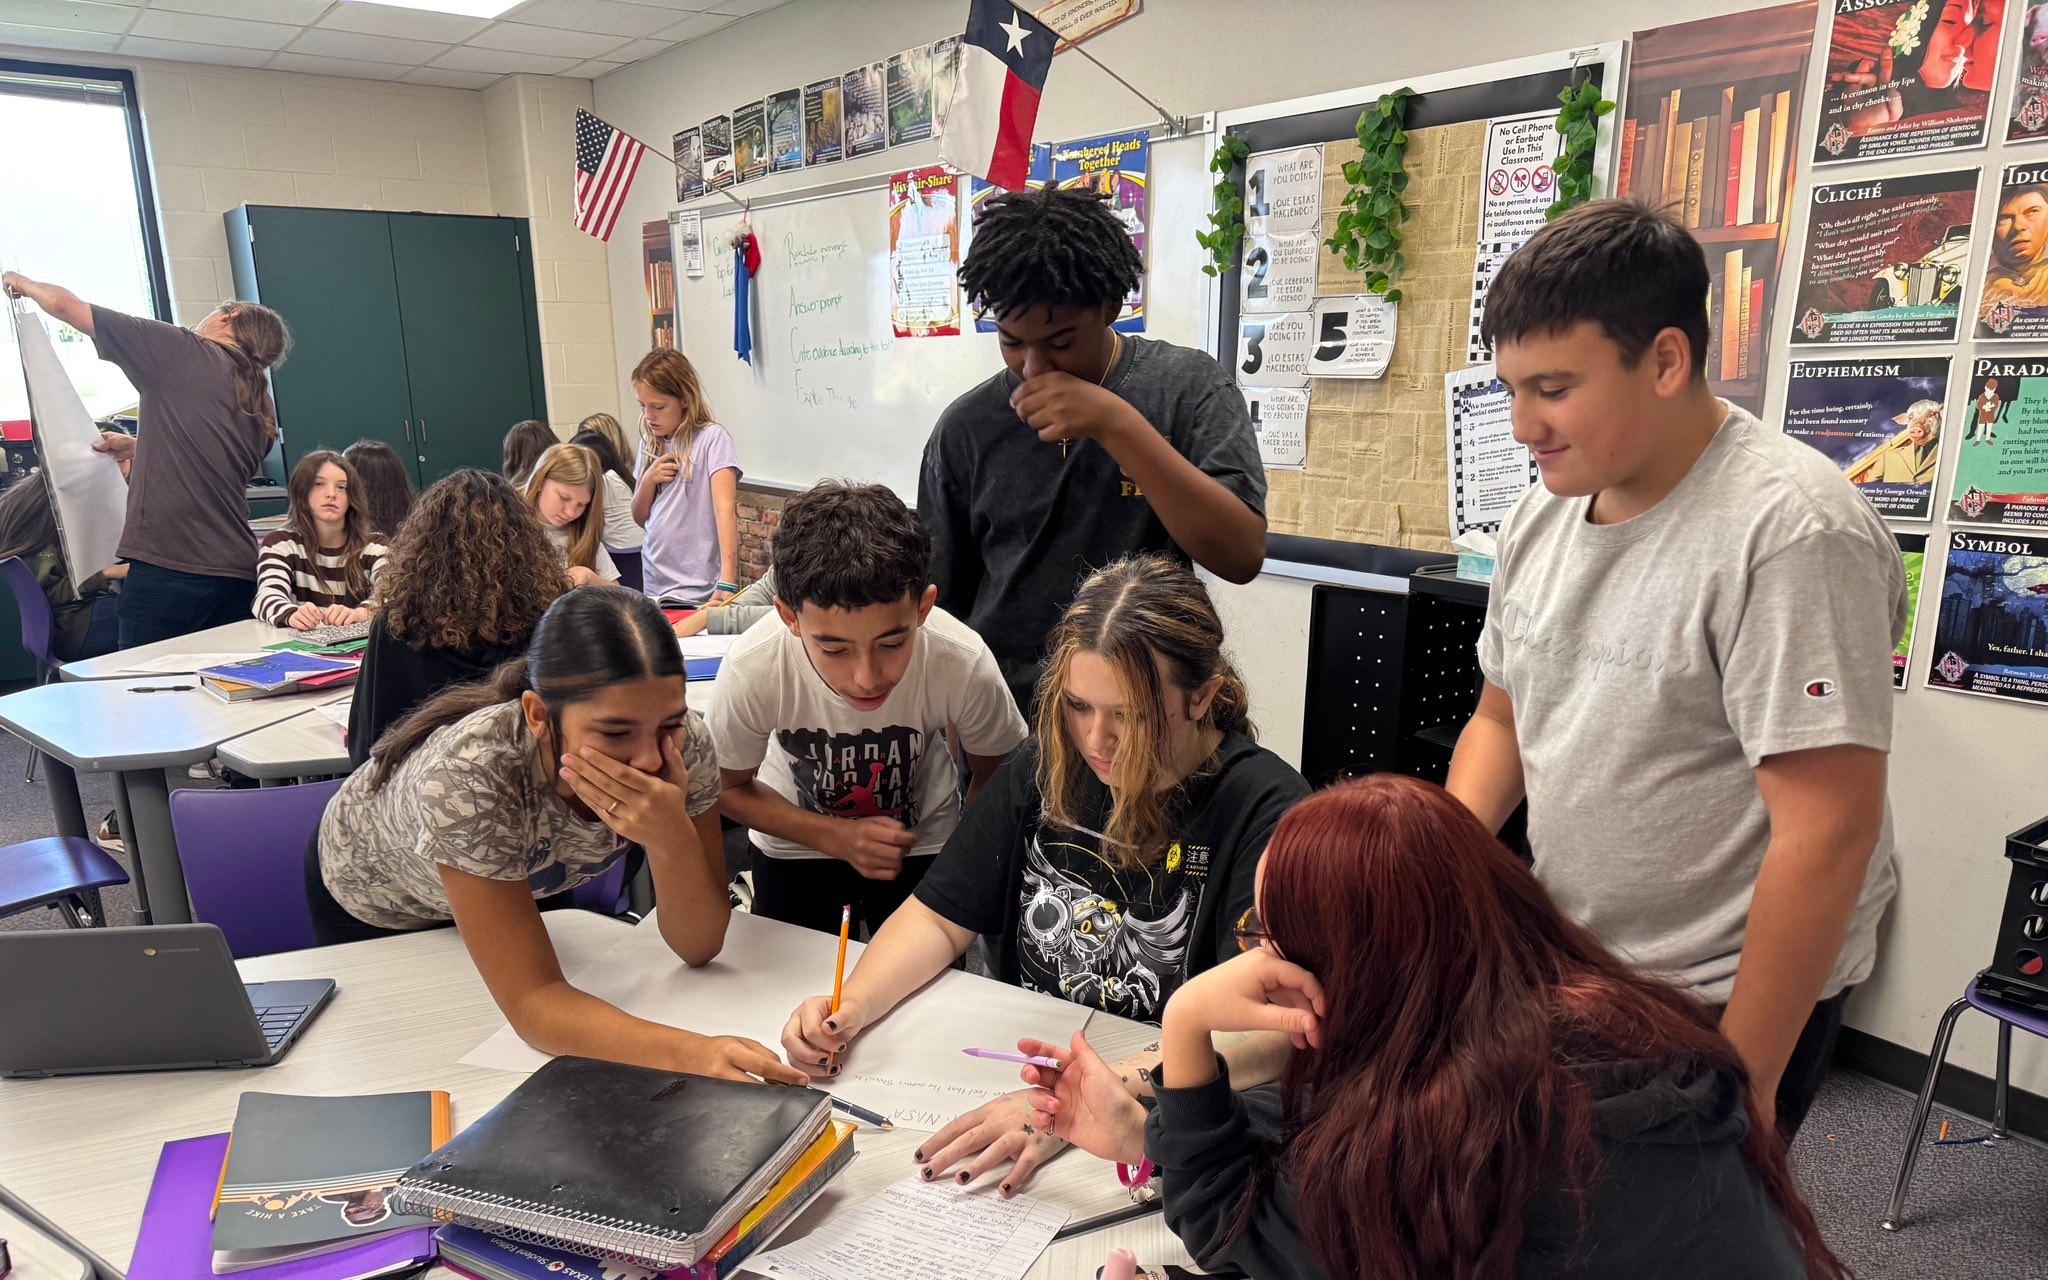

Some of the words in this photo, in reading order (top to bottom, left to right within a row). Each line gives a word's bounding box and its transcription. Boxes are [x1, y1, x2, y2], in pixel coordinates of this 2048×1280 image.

[1060, 12, 1067, 20] OF
[1080, 10, 1093, 21] EVER
[1840, 92, 1847, 100] Is
[1848, 86, 1878, 98] crimson
[1888, 80, 1900, 89] thy
[1902, 77, 1916, 87] lips
[1828, 106, 1842, 115] and
[1852, 102, 1864, 111] thy
[1865, 95, 1892, 107] cheeks,
[1500, 128, 1510, 137] No
[1512, 124, 1527, 135] Cell
[1528, 122, 1553, 133] Phone
[1516, 133, 1545, 144] Earbud
[1112, 138, 1141, 155] Heads
[1503, 147, 1516, 156] Use
[1518, 145, 1525, 154] In
[1527, 144, 1542, 153] This
[1078, 156, 1121, 172] Together
[1501, 152, 1544, 166] Classroom!
[1278, 162, 1297, 173] WHAT
[1300, 160, 1314, 169] ARE
[1273, 176, 1288, 185] YOU
[1290, 171, 1318, 183] DOING?
[1248, 169, 1270, 217] 1
[1814, 183, 1882, 204] CLICHÉ
[1488, 200, 1498, 208] No
[1506, 197, 1531, 209] permite
[1532, 196, 1538, 204] el
[1274, 206, 1314, 219] HACIENDO?
[1852, 216, 1860, 224] all
[1892, 202, 1905, 212] said
[1246, 246, 1269, 299] 2
[820, 294, 842, 314] prompt
[1272, 322, 1285, 331] ARE
[1287, 322, 1304, 330] YOU
[1269, 332, 1291, 341] DOING
[1294, 332, 1306, 341] IT?
[1314, 312, 1348, 362] 5
[1241, 325, 1265, 375] 3
[1792, 362, 1901, 379] EUPHEMISM
[1976, 360, 2048, 377] PARAD
[1480, 398, 1507, 409] honored
[1826, 406, 1845, 414] being,
[1845, 402, 1874, 411] certainly,
[2024, 397, 2041, 406] They
[1469, 409, 1487, 418] social
[2022, 408, 2031, 416] By
[2033, 407, 2045, 415] the
[1840, 418, 1869, 426] necessary
[2020, 420, 2031, 428] my
[2018, 427, 2032, 435] had
[2024, 447, 2041, 455] hide
[1998, 468, 2012, 476] and
[1952, 532, 2033, 556] SYMBOL
[1502, 601, 1691, 681] Champion
[1988, 642, 2003, 653] Yes,
[2003, 645, 2028, 655] father.
[2030, 648, 2034, 656] I
[1186, 850, 1210, 864] 注意
[245, 1209, 273, 1220] HIKE
[290, 1204, 323, 1218] TAKE
[491, 1237, 519, 1254] Edition
[518, 1250, 550, 1266] Student
